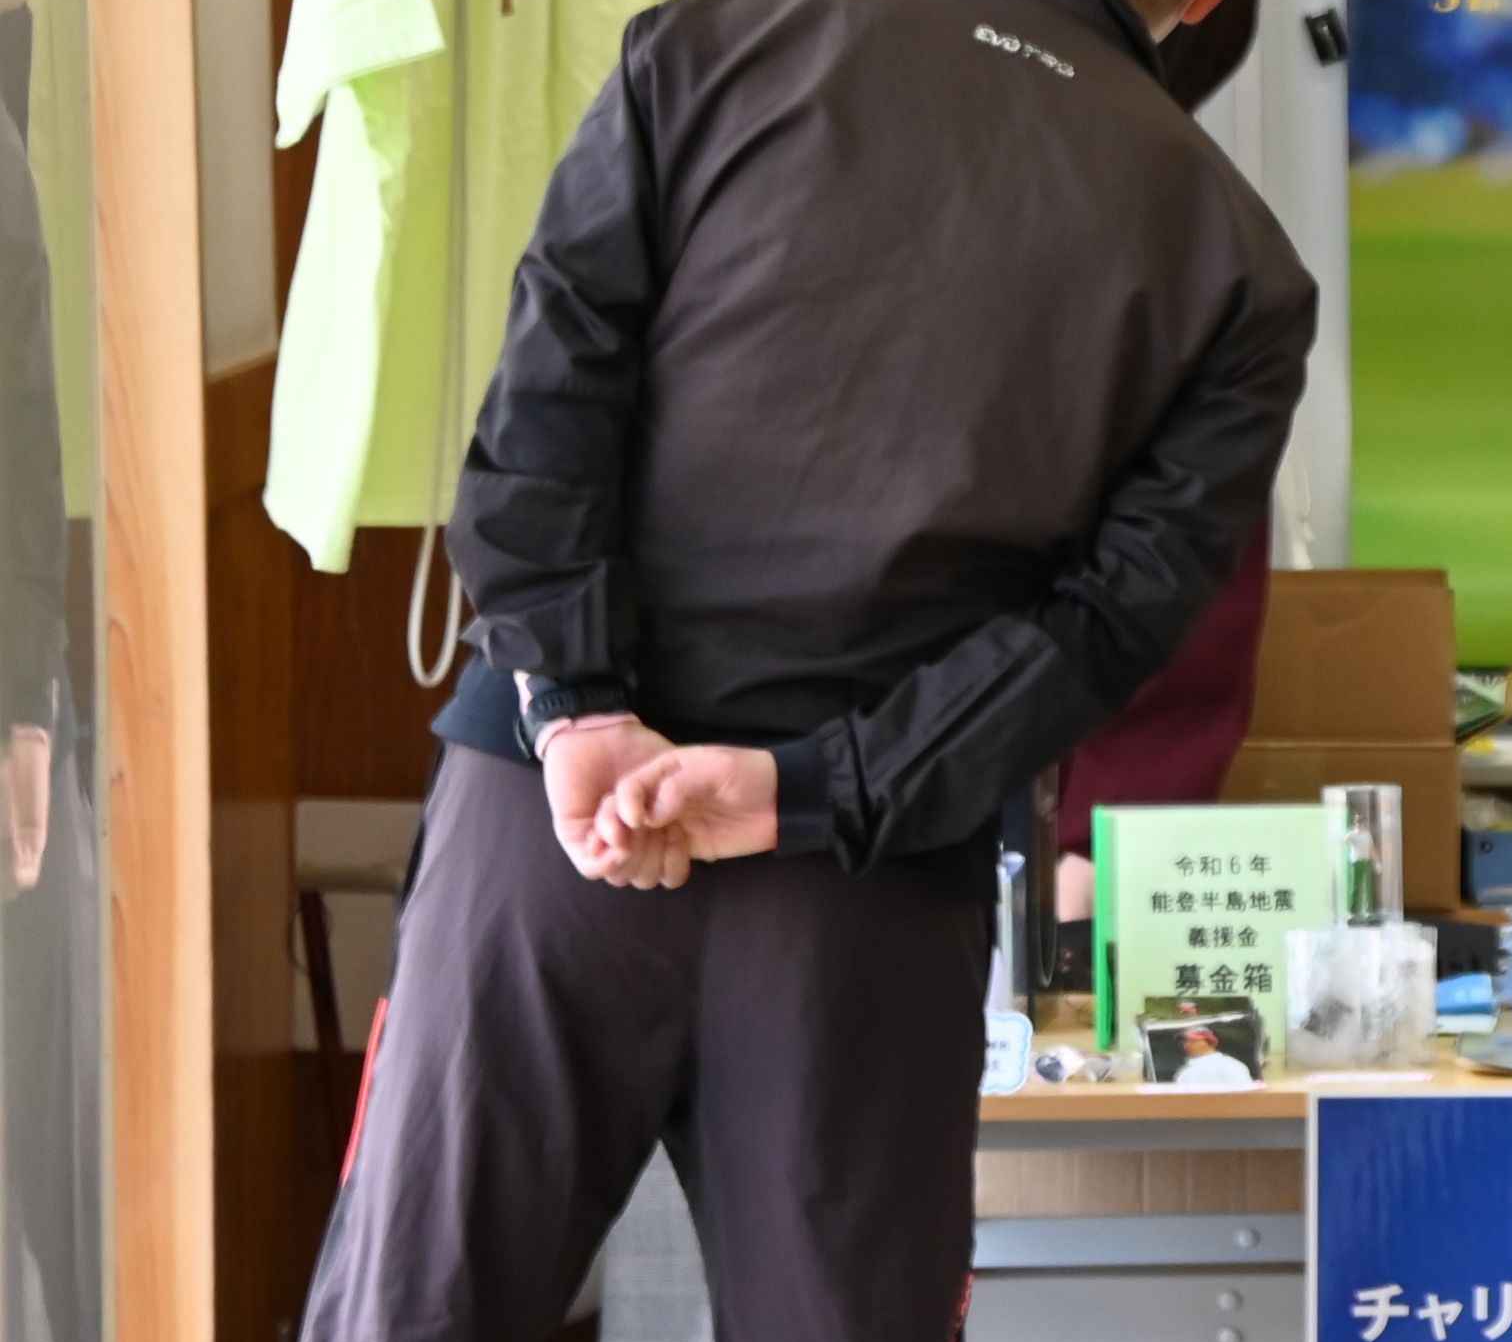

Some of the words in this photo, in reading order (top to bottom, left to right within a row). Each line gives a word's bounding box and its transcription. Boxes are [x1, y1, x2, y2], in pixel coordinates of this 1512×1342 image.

[1151, 888, 1296, 913] 能登半島地震
[1187, 925, 1260, 949] 義援金
[1174, 963, 1274, 996] 募金箱
